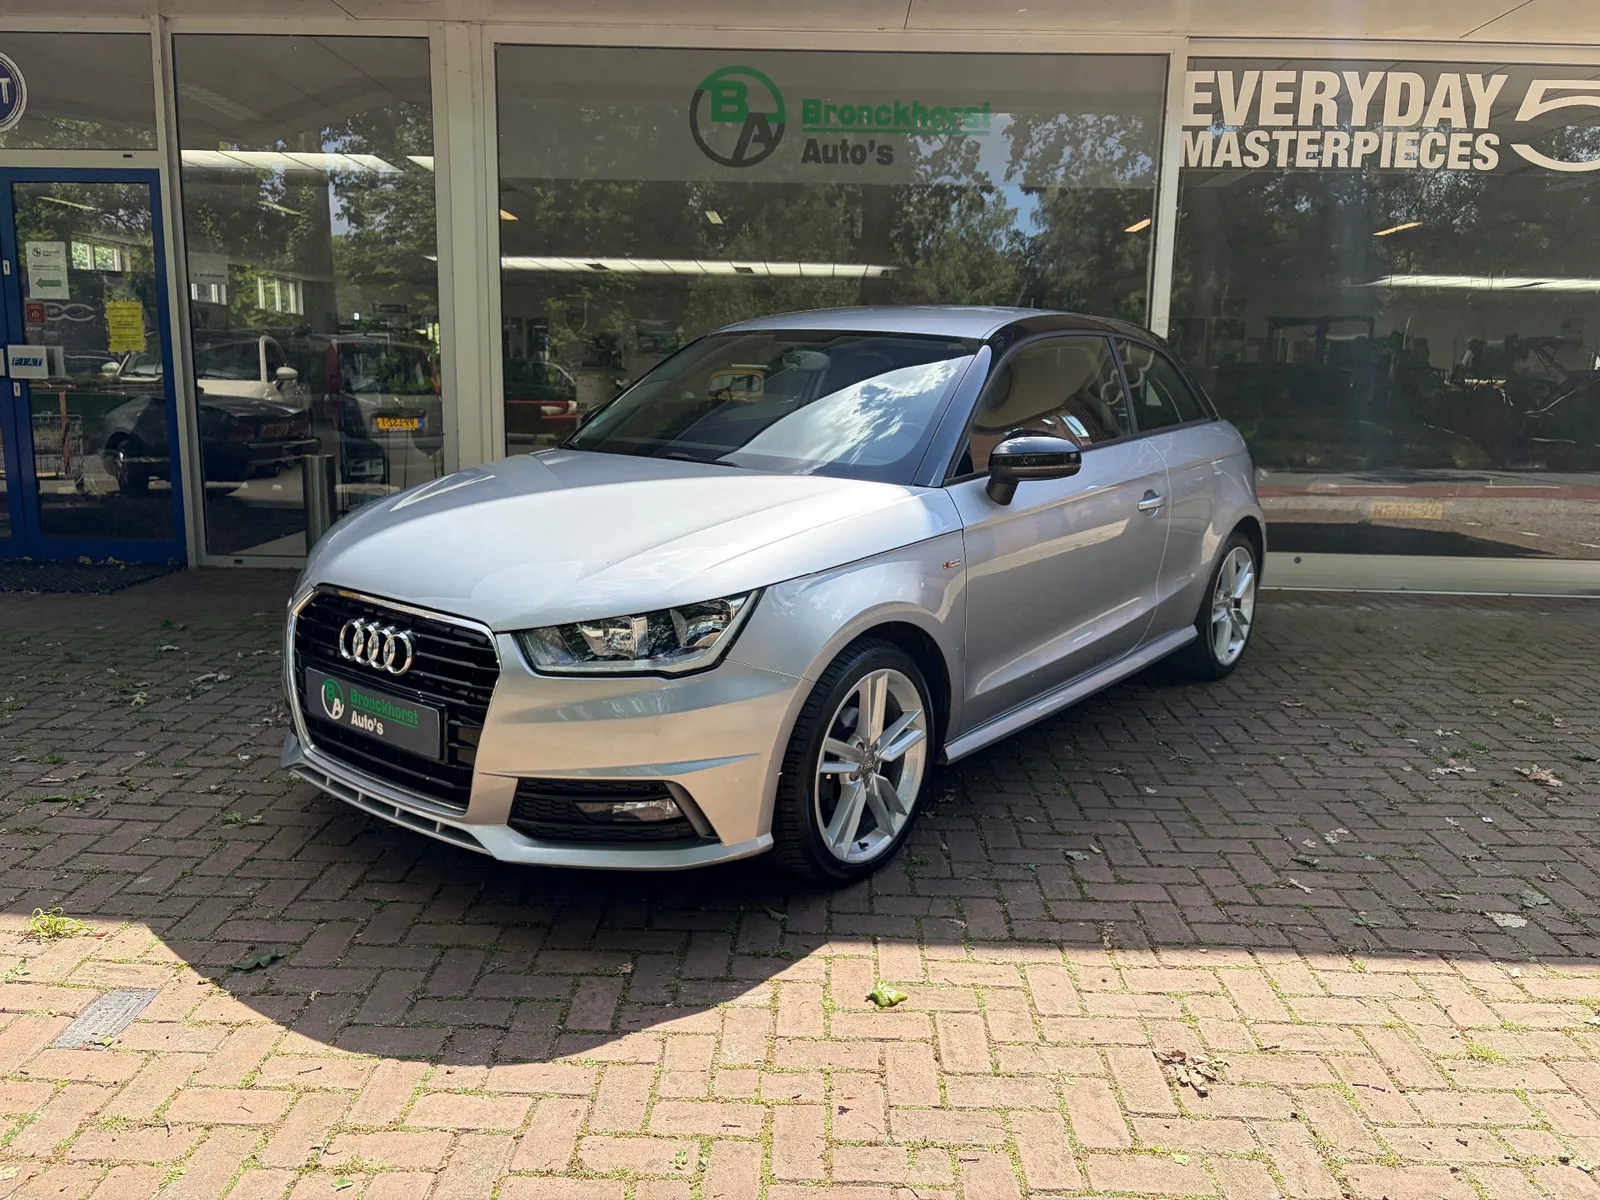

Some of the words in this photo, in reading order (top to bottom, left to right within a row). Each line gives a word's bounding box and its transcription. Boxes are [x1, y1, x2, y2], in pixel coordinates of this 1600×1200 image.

[801, 98, 990, 128] Bronckhorst
[1182, 70, 1509, 129] EVERYDAY
[801, 138, 894, 166] Auto's
[1178, 131, 1500, 171] MASTERPIECES
[12, 358, 43, 366] FIAT
[350, 688, 419, 725] Bronckhorst
[350, 710, 384, 735] Auto's
